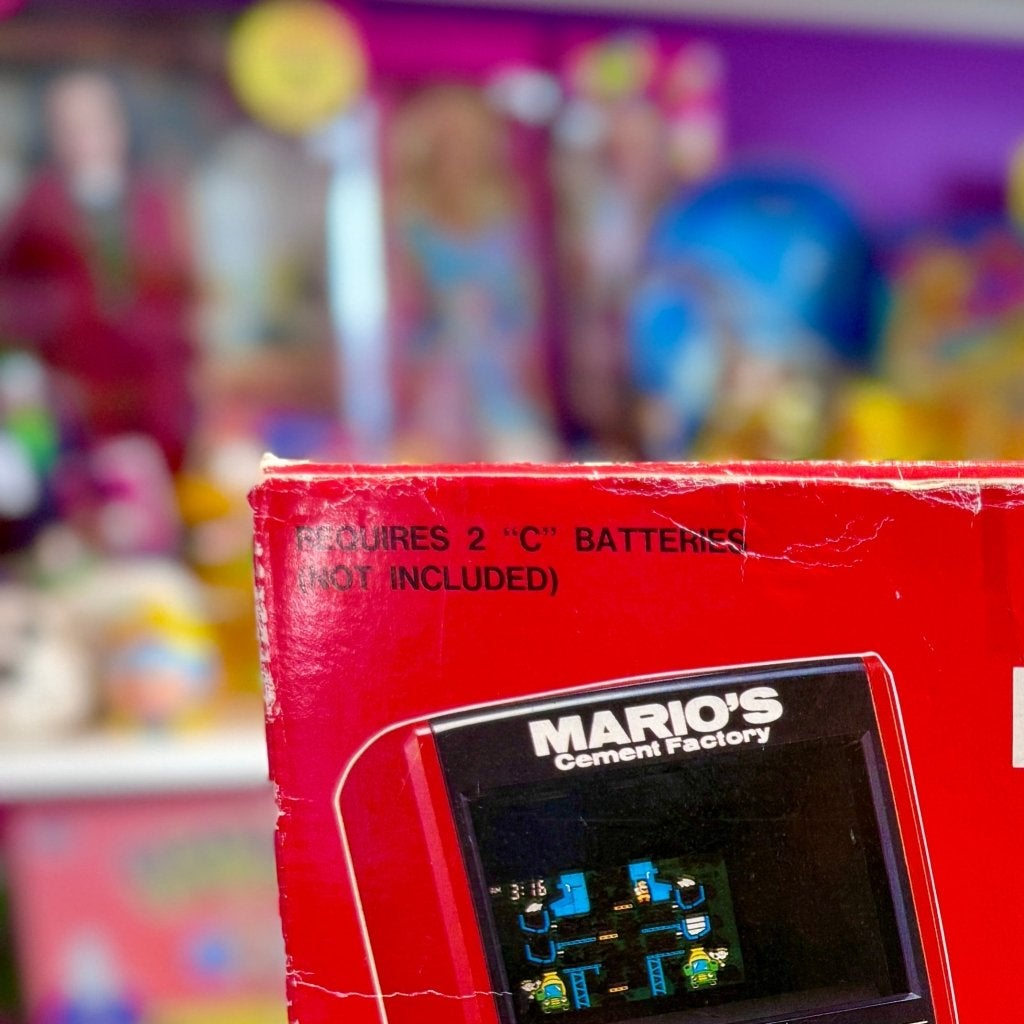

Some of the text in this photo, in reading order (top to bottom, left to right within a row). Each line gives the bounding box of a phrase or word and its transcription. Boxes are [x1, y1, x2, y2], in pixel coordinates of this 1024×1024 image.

[296, 526, 449, 551] REQUIRES
[467, 526, 486, 551] 2
[575, 526, 747, 554] BATTERIES
[299, 564, 558, 596] (NOT INCLUDED)
[528, 687, 783, 757] MARIO'S
[555, 727, 770, 771] Cement Factory
[511, 880, 547, 900] 3:16
